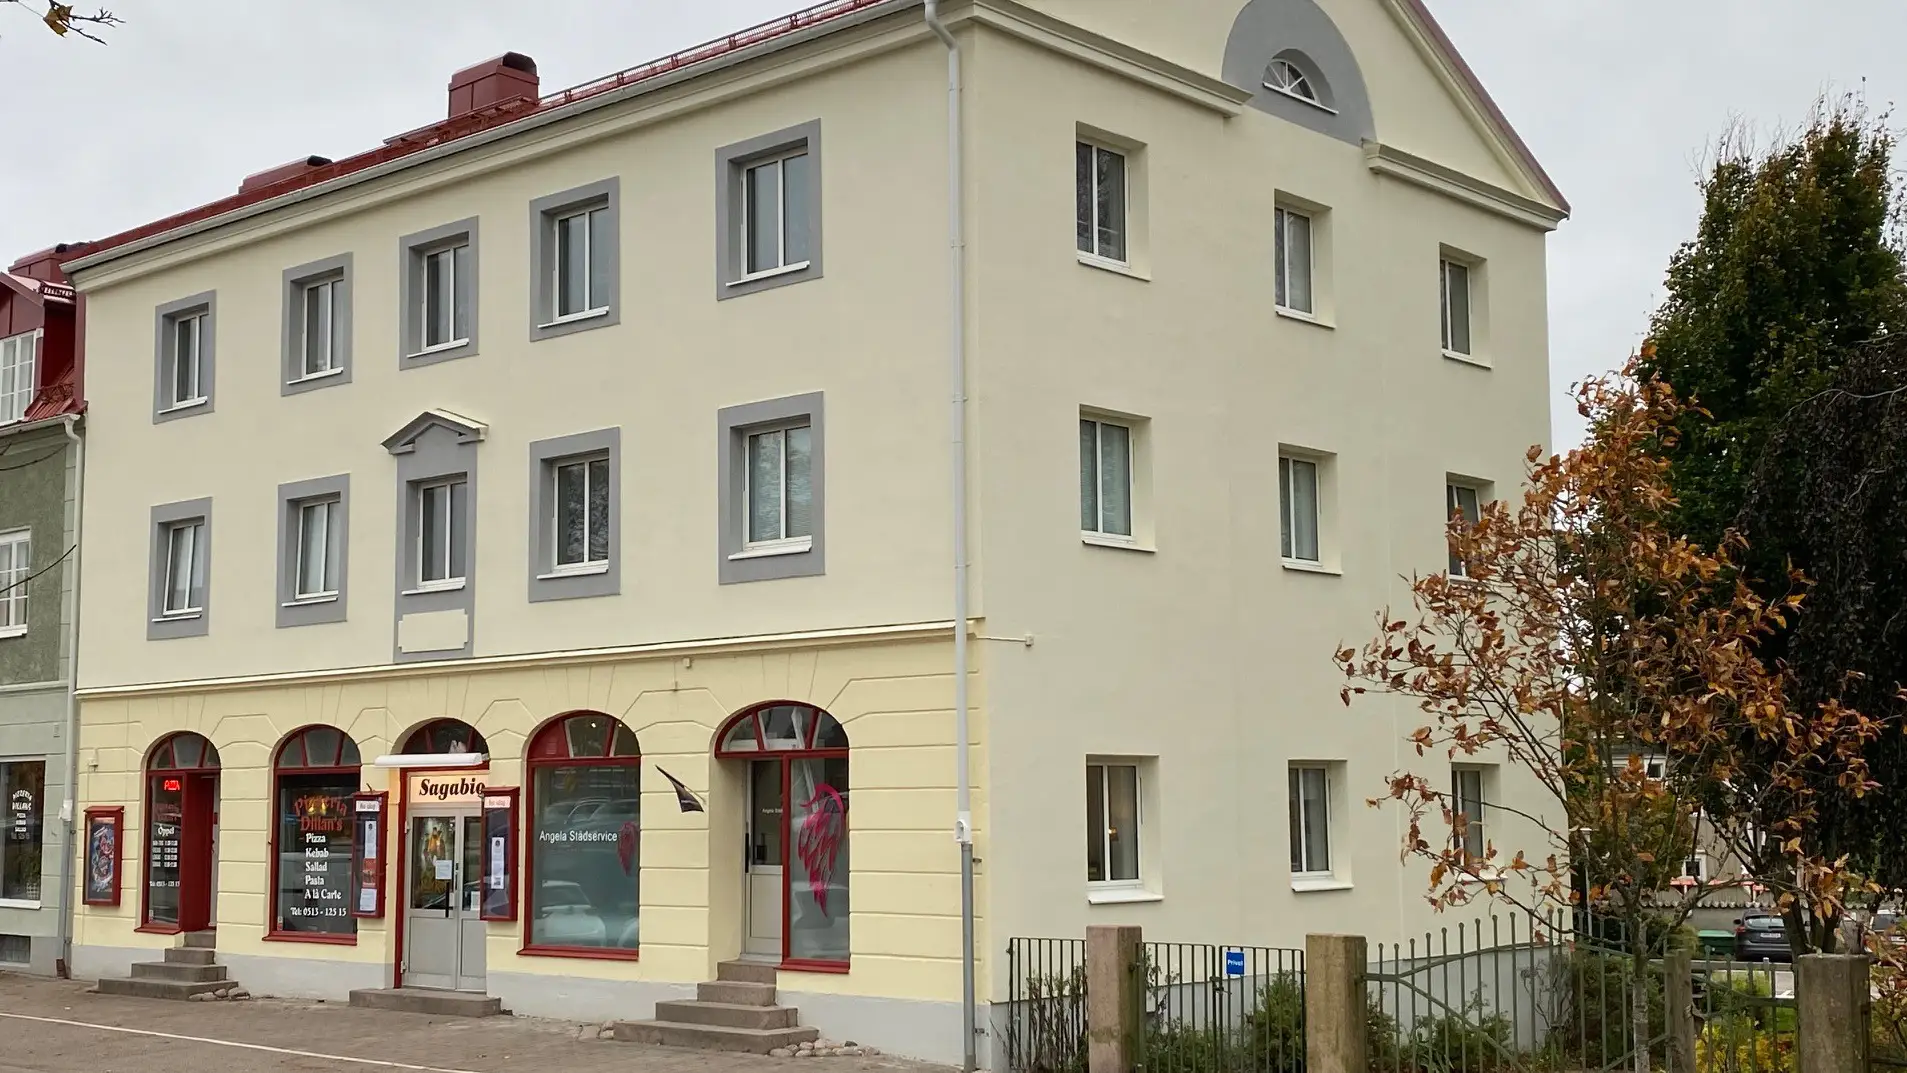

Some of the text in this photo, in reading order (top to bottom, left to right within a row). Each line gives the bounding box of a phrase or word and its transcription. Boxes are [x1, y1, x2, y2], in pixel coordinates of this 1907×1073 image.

[305, 833, 326, 843] Pizza
[539, 830, 618, 844] Angela Städservice
[305, 847, 329, 858] Kebab
[305, 861, 328, 872] Sallad
[304, 874, 325, 886] Pasta
[304, 888, 312, 900] A
[321, 888, 342, 900] Carte
[303, 907, 319, 917] 0513
[325, 907, 337, 917] 125
[339, 907, 347, 917] 15
